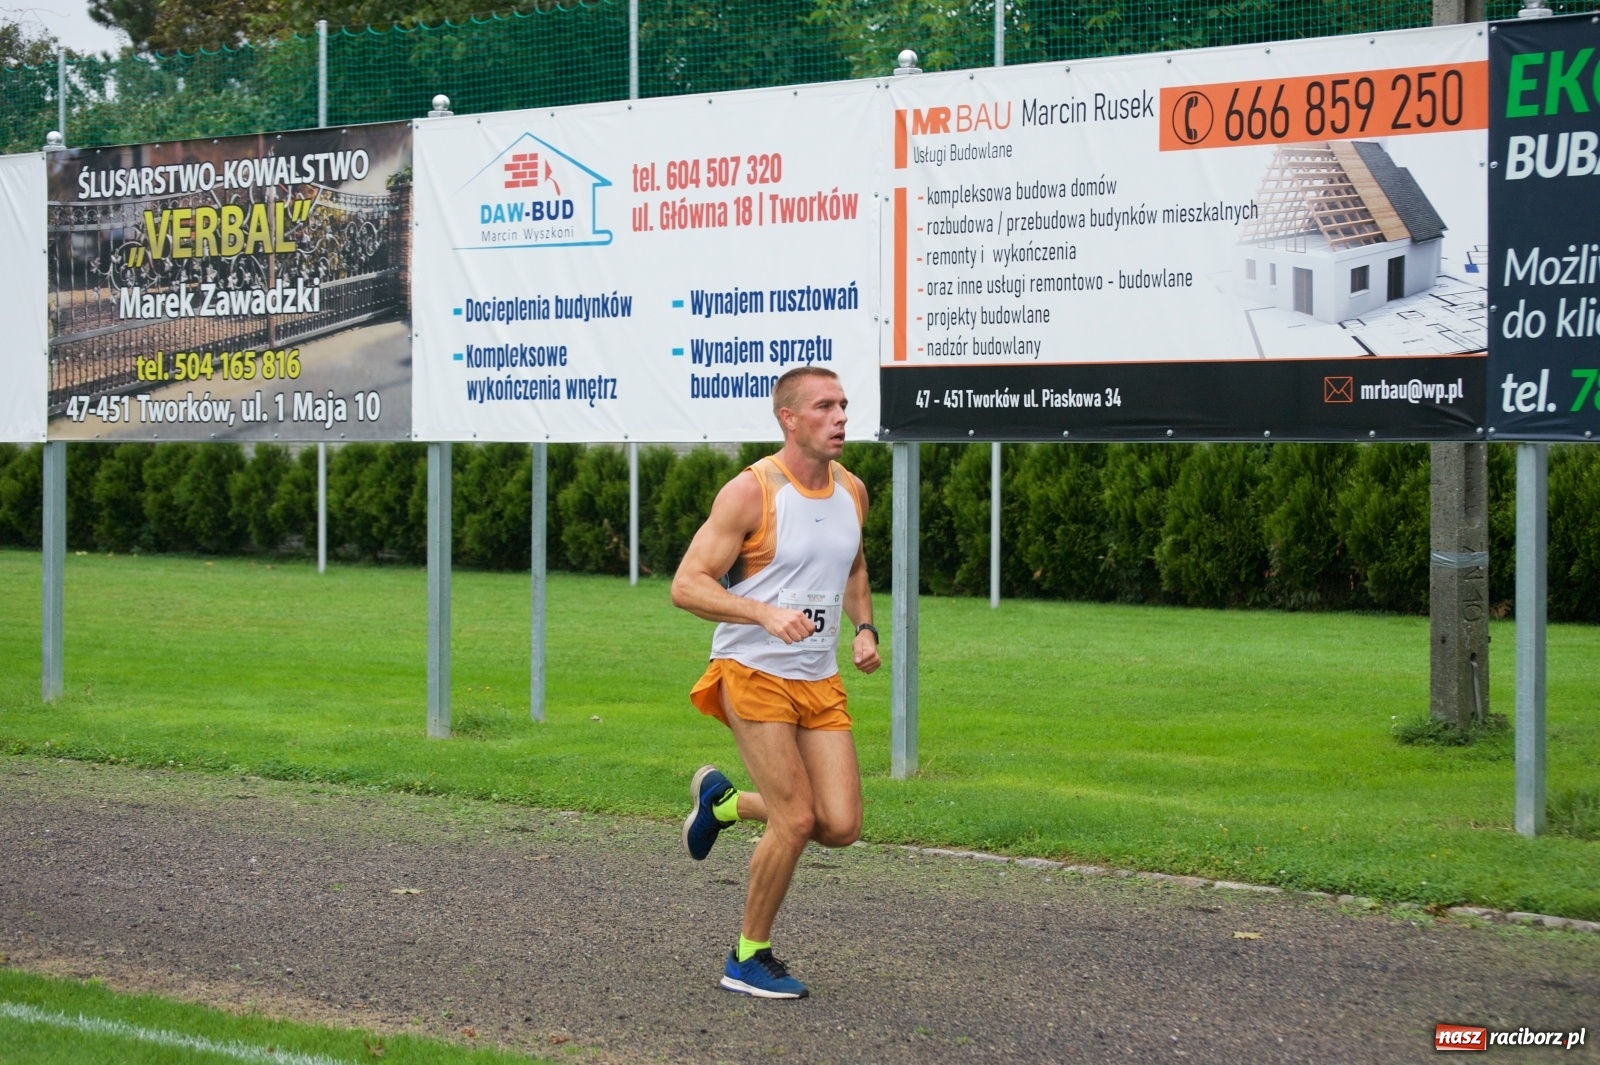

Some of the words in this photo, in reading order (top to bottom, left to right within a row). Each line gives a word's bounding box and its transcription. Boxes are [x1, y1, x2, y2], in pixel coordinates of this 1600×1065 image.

[1506, 48, 1600, 118] EK
[1022, 97, 1086, 127] Marcin
[1094, 89, 1154, 121] Rusek
[1225, 84, 1289, 141] 666
[1306, 77, 1375, 136] 859
[1390, 70, 1462, 130] 250
[914, 144, 946, 166] Usługi
[950, 142, 1012, 161] Budowlane
[79, 149, 370, 199] ŚLUSARSTWO-KOWALSTWO
[633, 163, 660, 192] tel.
[667, 159, 700, 190] 604
[707, 156, 741, 187] 507
[747, 153, 782, 184] 320
[928, 184, 1011, 208] kompleksowa
[1017, 180, 1065, 200] budowa
[1071, 174, 1117, 196] domów
[481, 200, 574, 224] DAW-BUD
[632, 203, 653, 232] ul.
[660, 197, 728, 230] Główna
[734, 196, 752, 226] 18
[770, 187, 858, 224] Tworków
[928, 215, 993, 235] rozbudowa
[1007, 211, 1085, 236] przebudowa
[1090, 203, 1157, 231] budynków
[1163, 200, 1258, 226] mieszkalnych
[482, 229, 517, 242] Marcin
[524, 226, 574, 242] Wyszkoni
[926, 245, 976, 268] remonty
[981, 246, 984, 264] i
[993, 241, 1076, 268] wykończenia
[1504, 244, 1600, 286] Możli
[120, 284, 195, 319] Marek
[200, 278, 320, 317] Zawadzki
[691, 287, 763, 318] Wynajem
[770, 281, 858, 312] rusztowań
[927, 280, 953, 296] oraz
[958, 275, 982, 294] inne
[987, 274, 1025, 298] usługi
[1030, 273, 1102, 293] remontowo
[1119, 270, 1192, 289] budowlane
[466, 295, 550, 325] Docieplenia
[555, 290, 632, 322] budynków
[927, 308, 977, 330] projekty
[981, 305, 1050, 326] budowlane
[1503, 299, 1546, 338] do
[1556, 297, 1600, 337] kli
[466, 343, 567, 371] Kompleksowe
[691, 337, 764, 367] Wynajem
[770, 335, 832, 366] sprzętu
[927, 336, 967, 356] nadzór
[973, 337, 1041, 359] budowlany
[136, 351, 169, 381] tel.
[174, 352, 213, 380] 504
[220, 351, 256, 379] 165
[262, 350, 300, 379] 816
[467, 374, 560, 404] wykończenia
[566, 375, 617, 408] wnętrz
[916, 390, 930, 408] 47
[943, 389, 964, 408] 451
[966, 388, 1020, 408] Tworków
[1024, 389, 1038, 407] ul.
[1042, 388, 1100, 407] Piaskowa
[1105, 388, 1121, 406] 34
[1361, 378, 1463, 404] mrbau@wp.pl
[1501, 368, 1556, 412] tel.
[67, 395, 129, 422] 47-451
[137, 392, 236, 424] Tworków,
[242, 391, 268, 422] ul.
[274, 394, 284, 420] 1
[293, 392, 346, 429] Maja
[355, 392, 380, 420] 10
